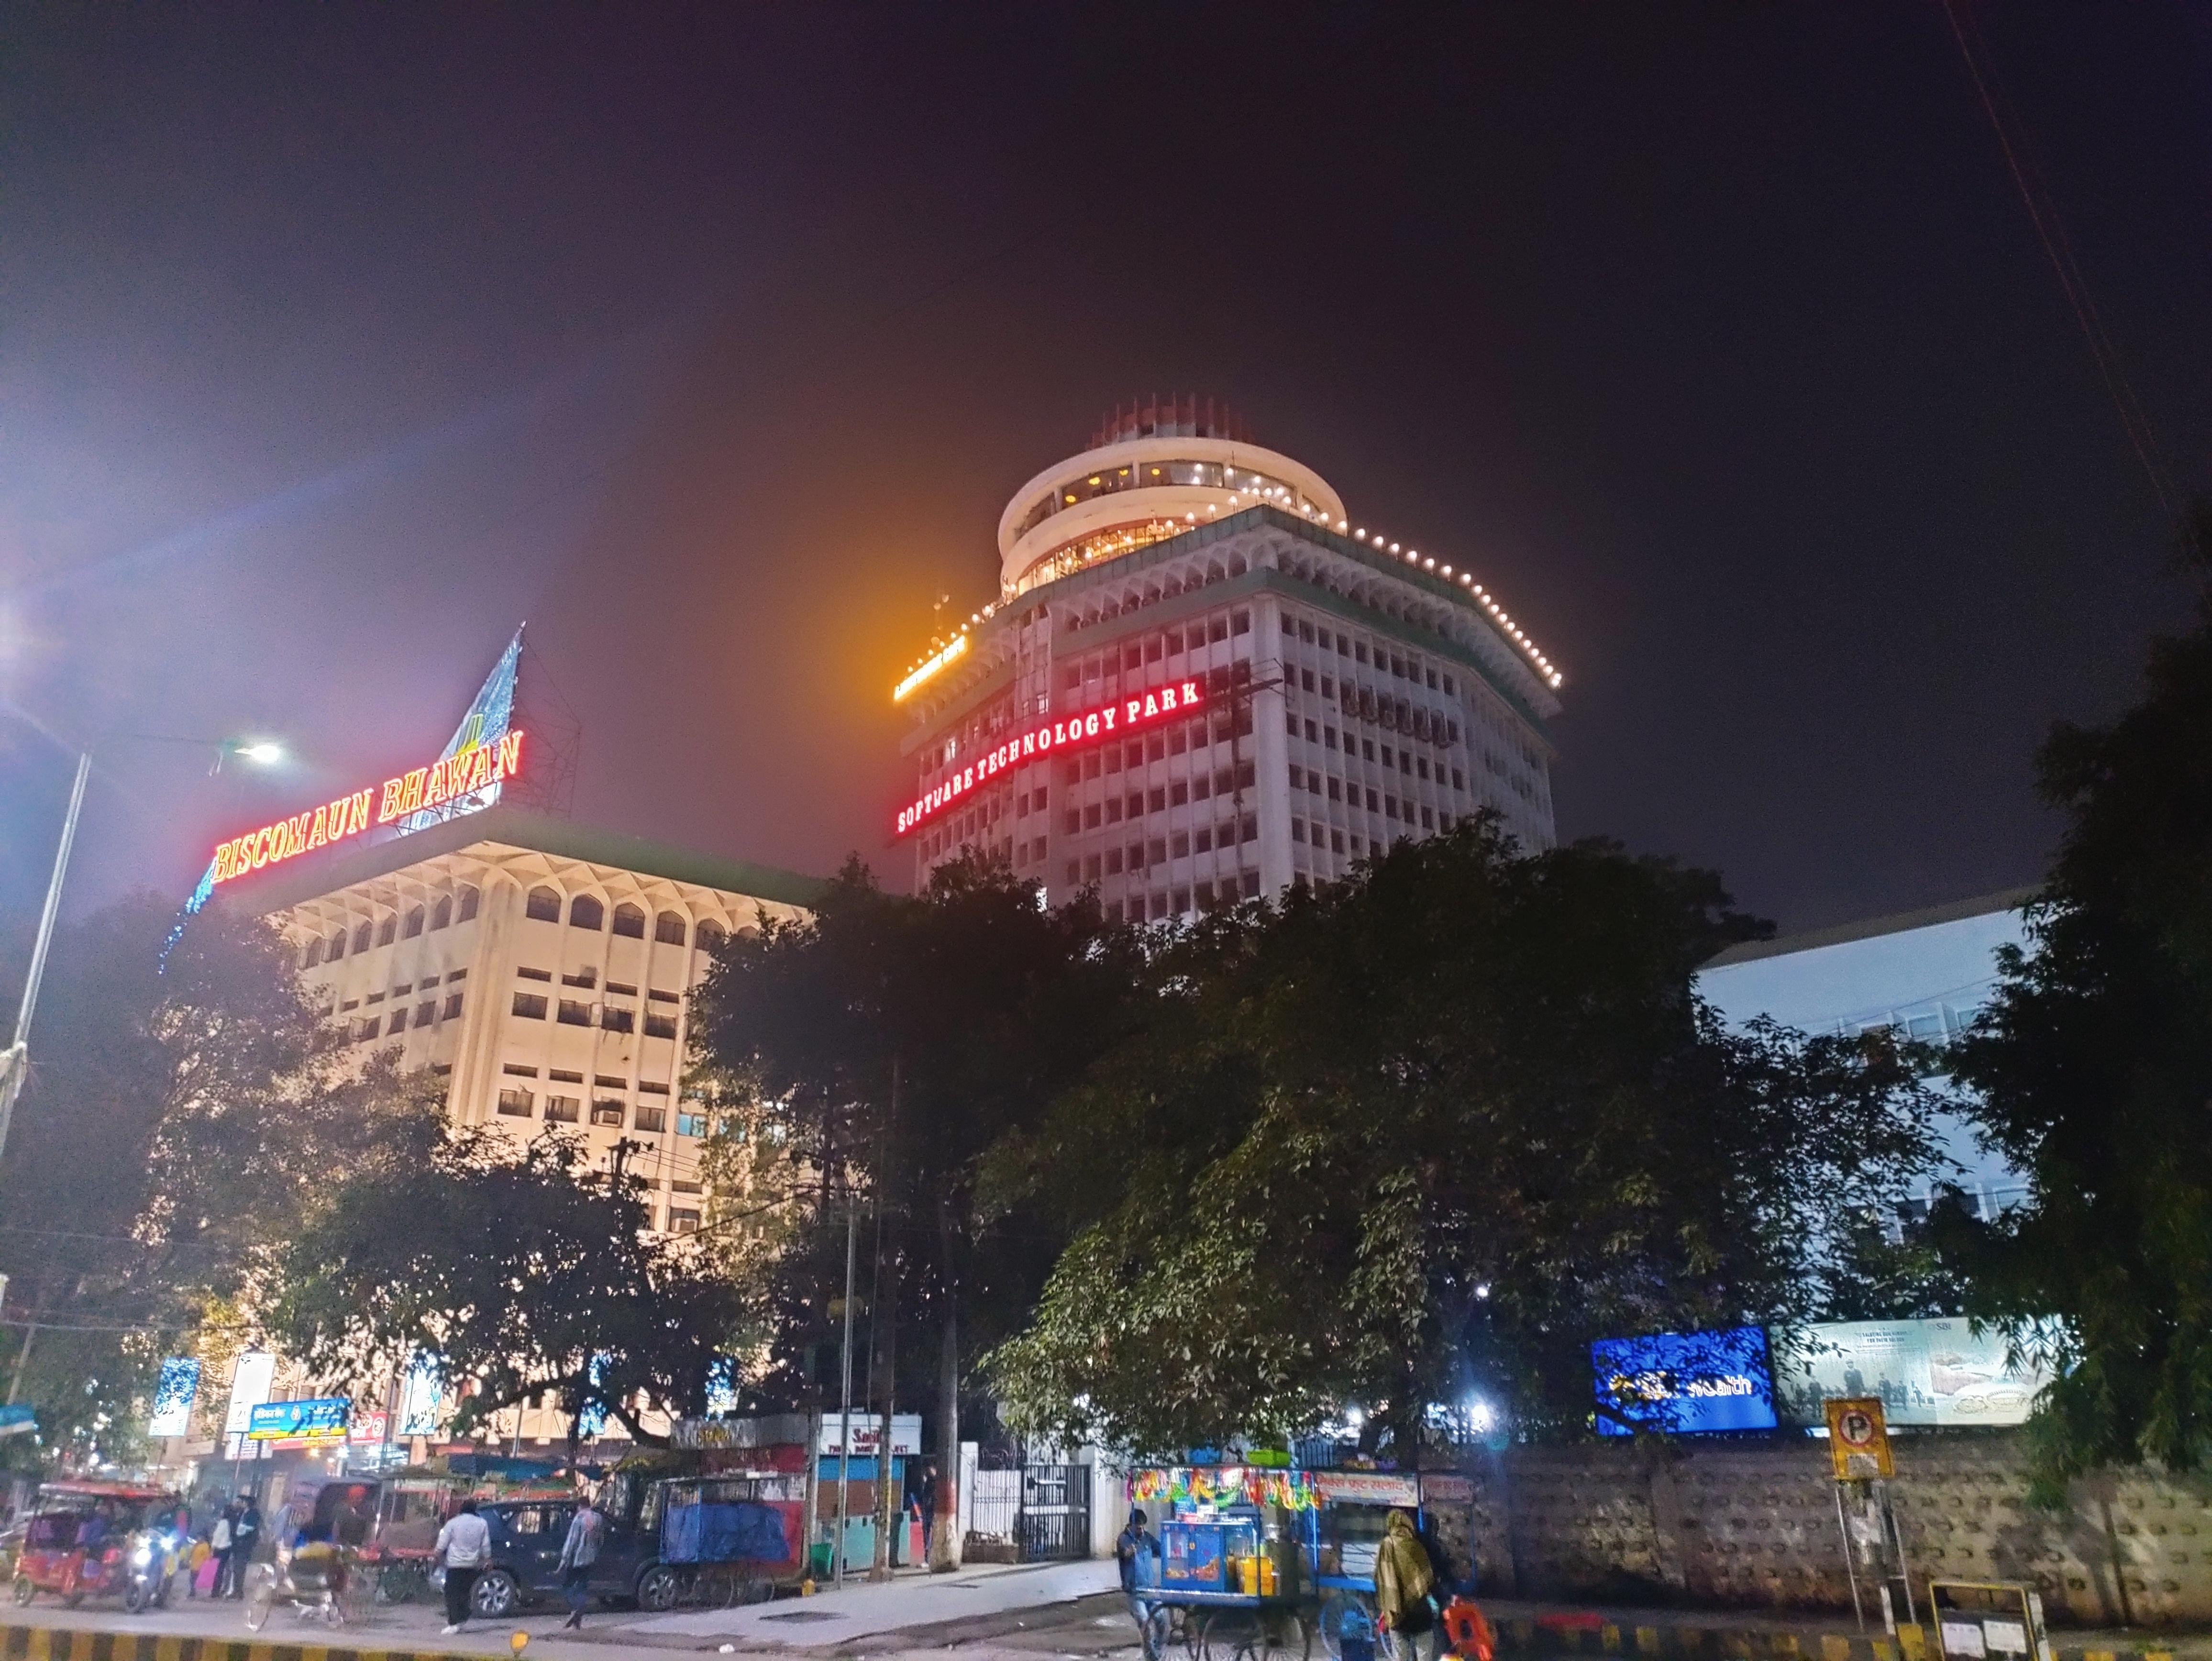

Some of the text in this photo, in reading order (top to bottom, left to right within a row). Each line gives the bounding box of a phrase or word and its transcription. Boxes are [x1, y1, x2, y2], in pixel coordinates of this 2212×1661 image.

[211, 731, 523, 884] BISCOMAUN BHAWAN
[897, 682, 1198, 833] SOFTWARE TECHNOLOGY PARK
[1848, 1416, 1867, 1440] P
